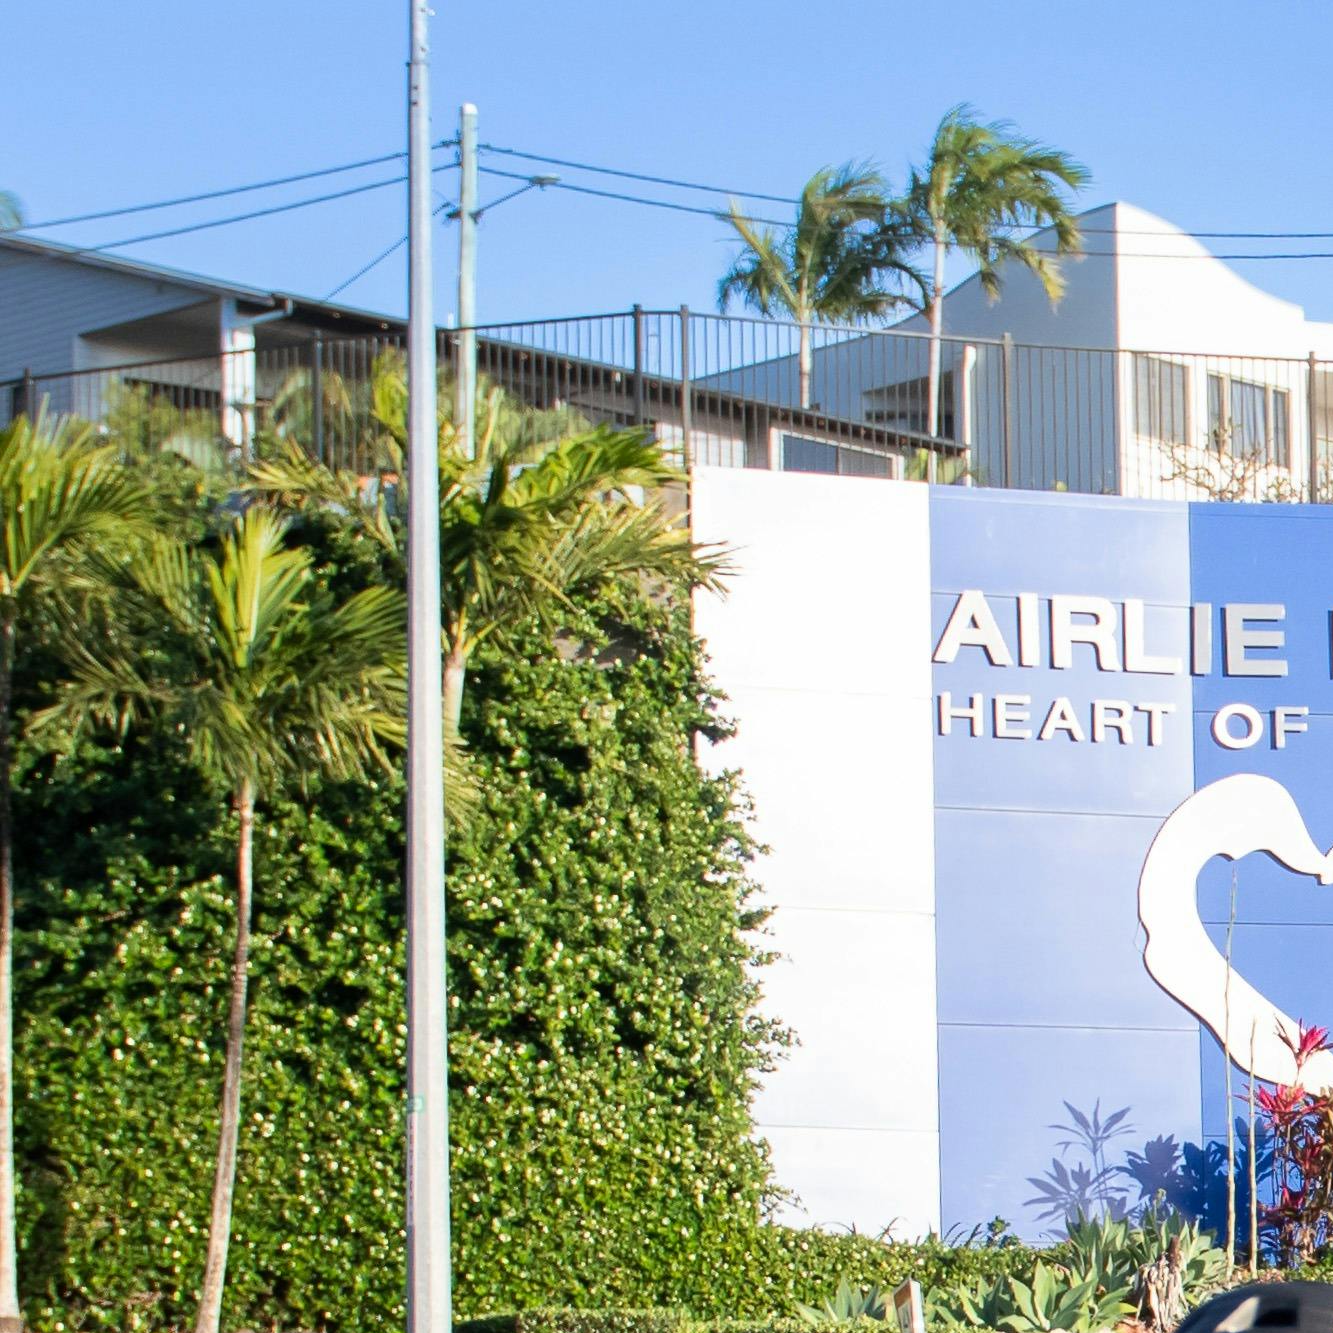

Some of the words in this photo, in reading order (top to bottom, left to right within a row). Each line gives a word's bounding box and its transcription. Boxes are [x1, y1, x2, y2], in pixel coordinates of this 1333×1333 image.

[933, 589, 1289, 677] AIRLIE
[935, 691, 1178, 747] HEART
[1209, 702, 1310, 750] OF
